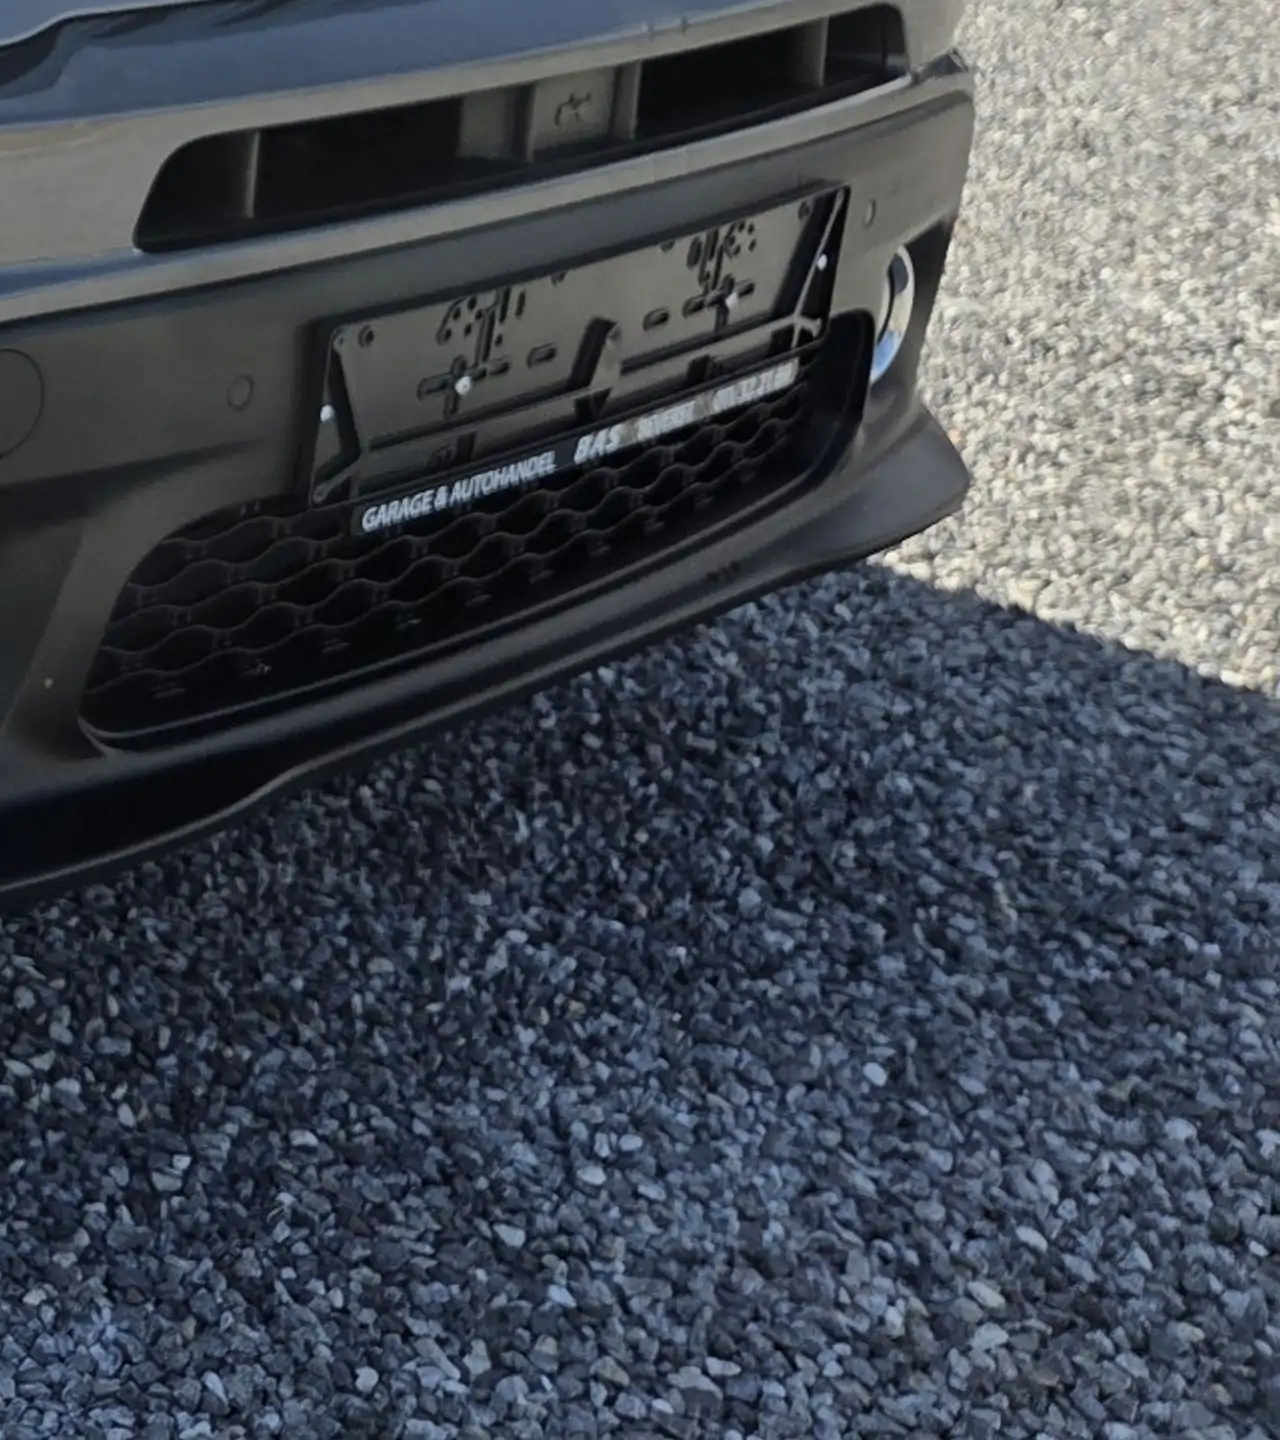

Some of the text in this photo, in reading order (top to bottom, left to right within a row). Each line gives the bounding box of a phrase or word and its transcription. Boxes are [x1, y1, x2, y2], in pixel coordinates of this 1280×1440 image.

[361, 489, 435, 533] GARAGE
[433, 485, 449, 509] &
[449, 450, 557, 506] AUTOHANDEL
